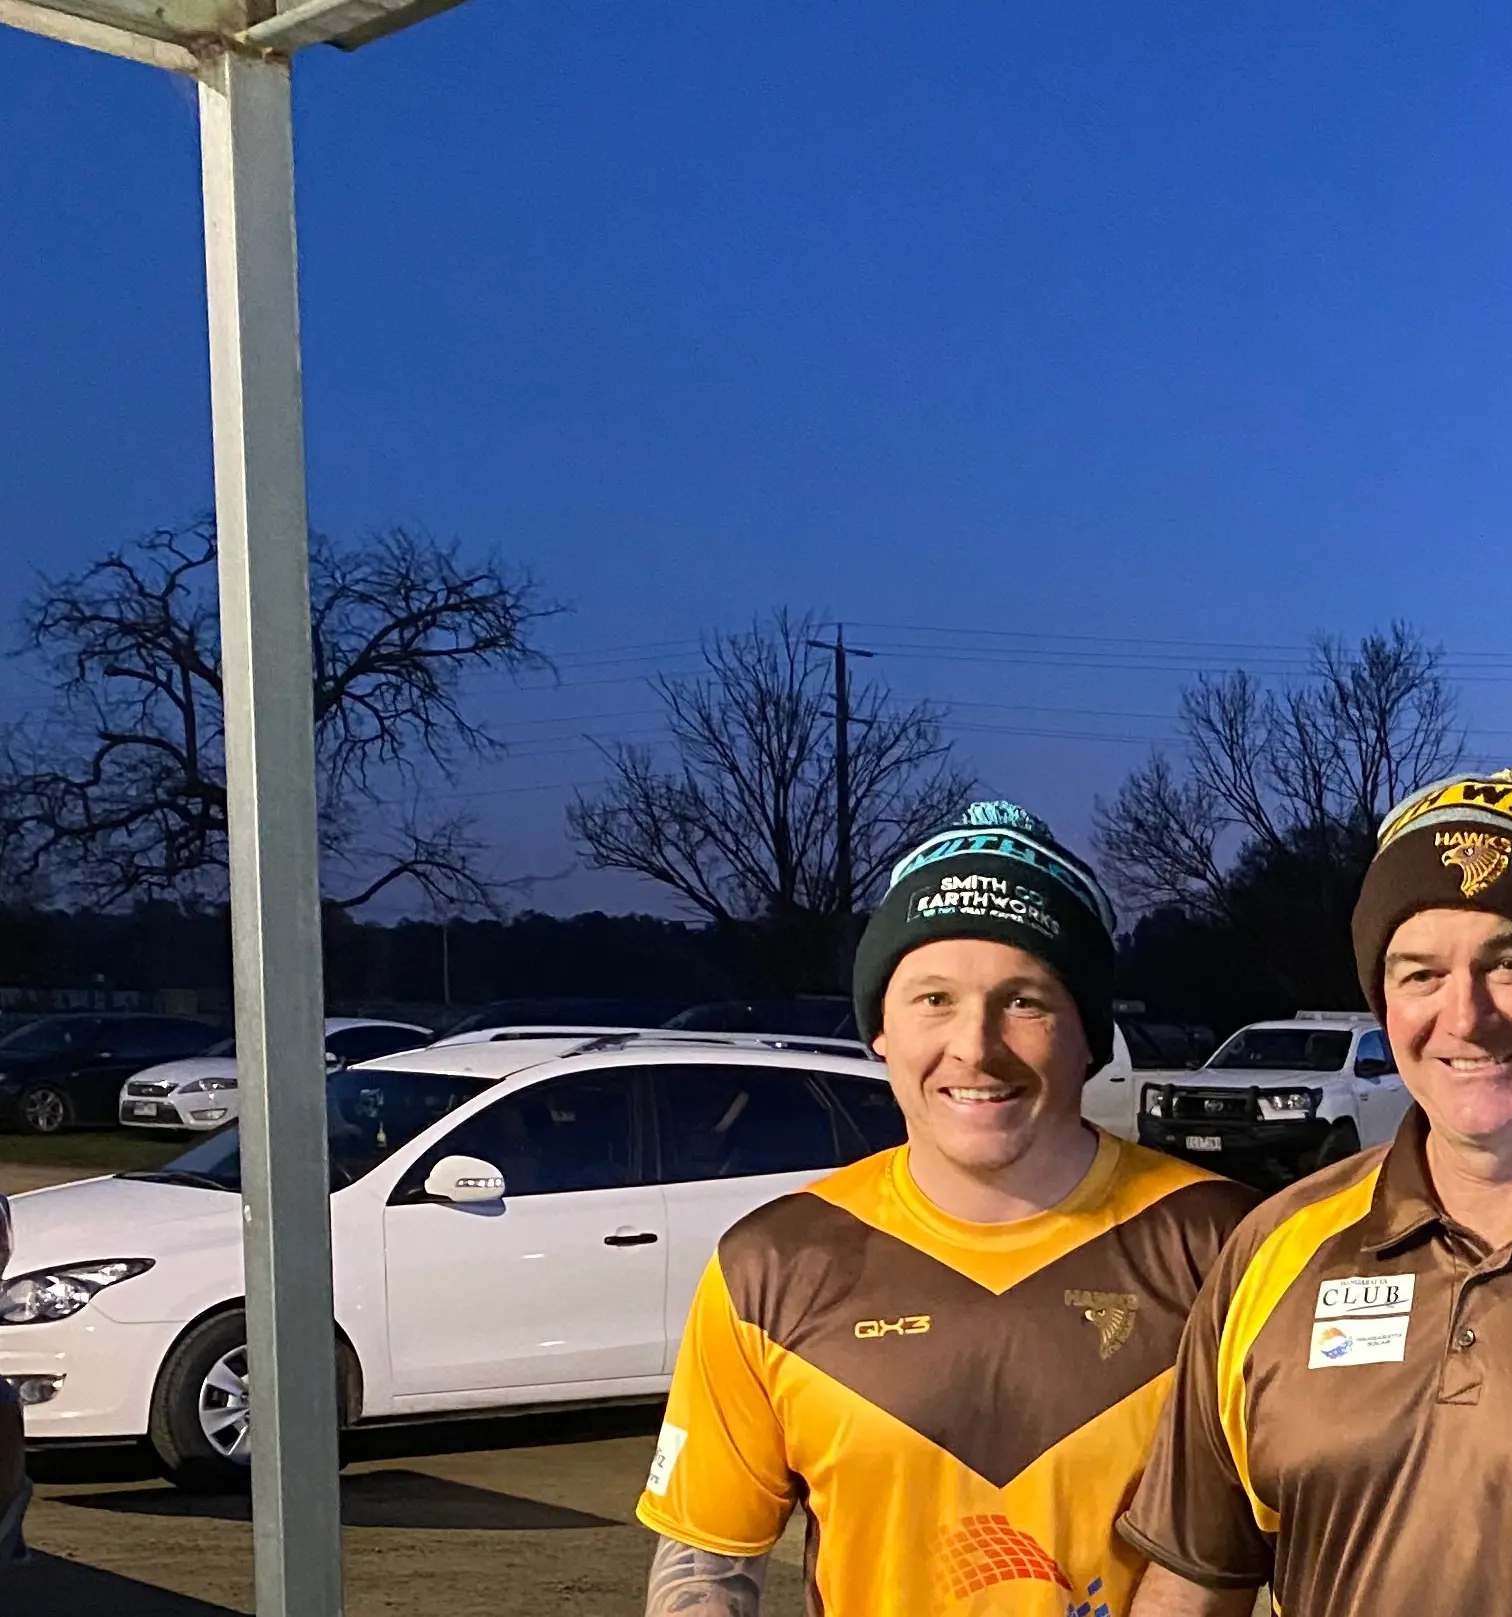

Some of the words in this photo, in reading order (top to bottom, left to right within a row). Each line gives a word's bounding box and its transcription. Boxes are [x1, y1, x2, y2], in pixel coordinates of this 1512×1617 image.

[1434, 831, 1512, 853] HAWKS
[940, 874, 1007, 894] SMITH
[1322, 1285, 1400, 1306] CLUB
[854, 1315, 932, 1338] QX3
